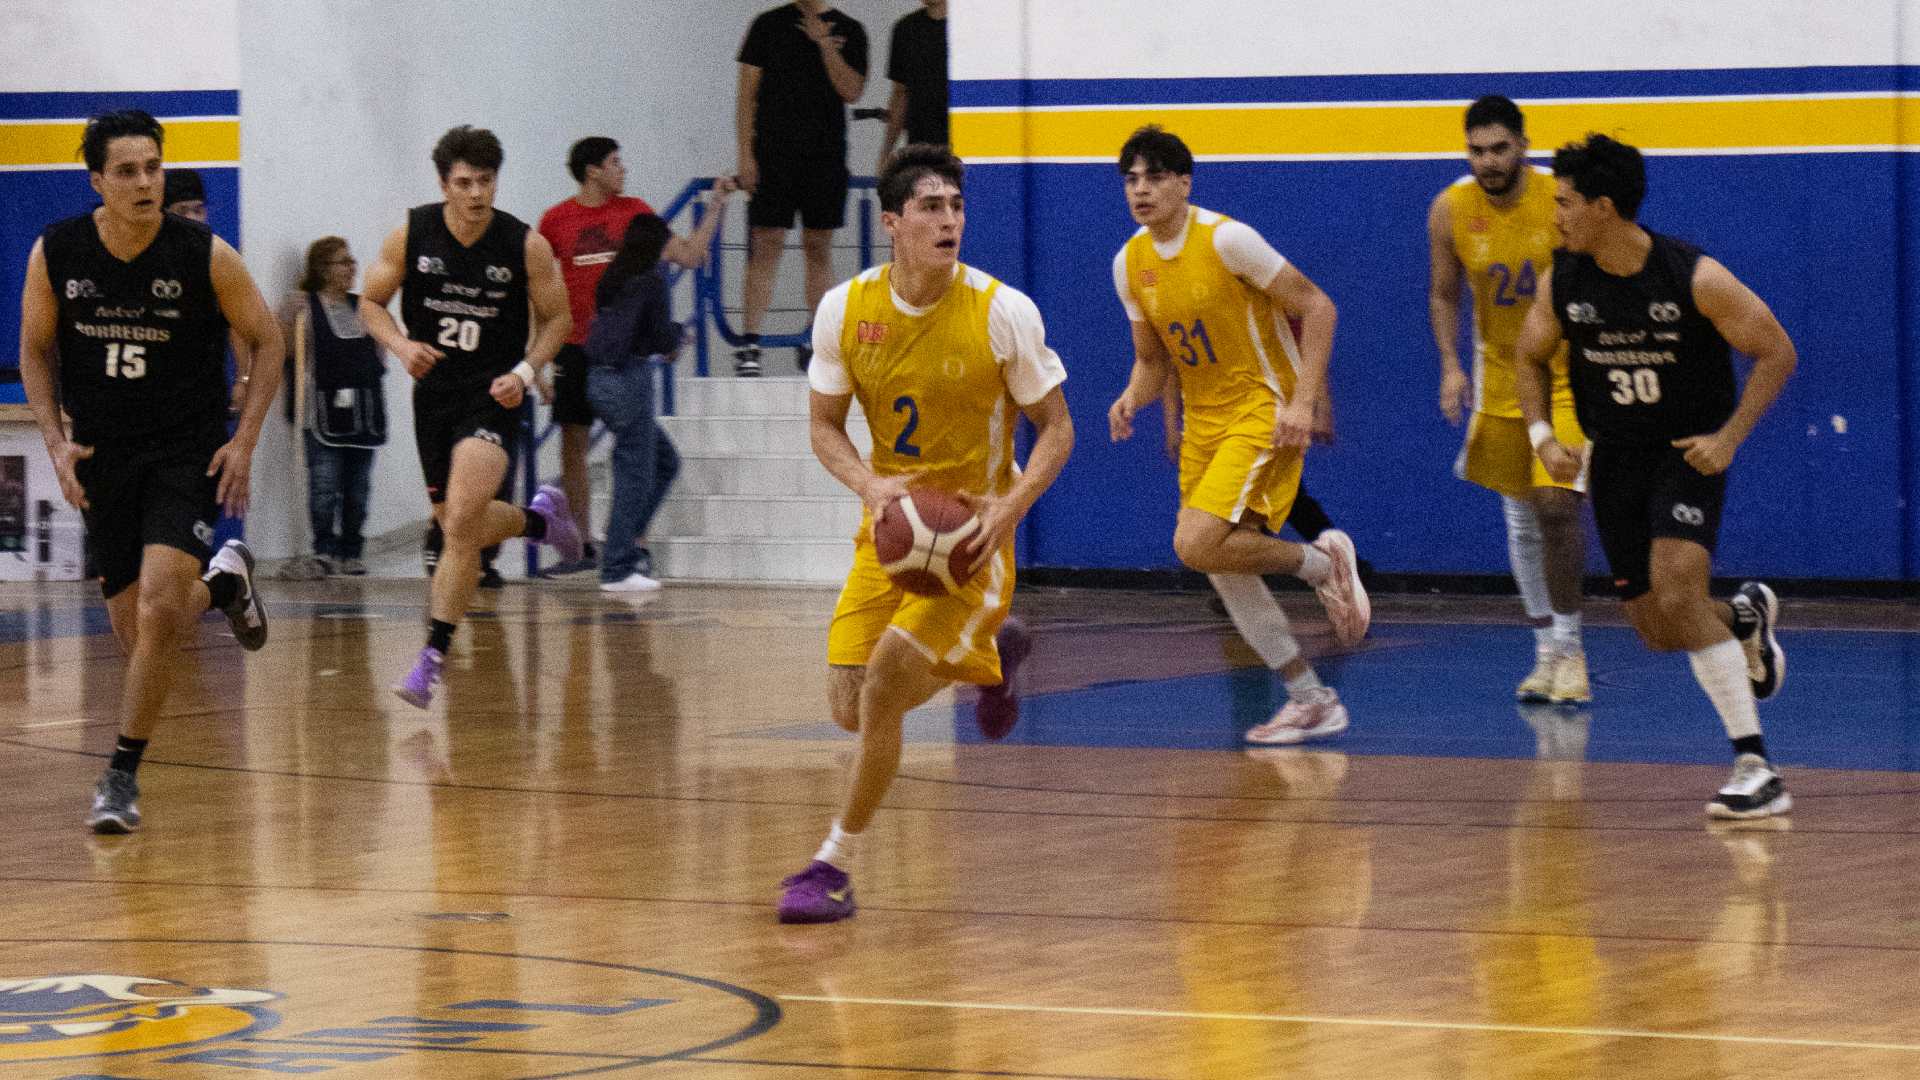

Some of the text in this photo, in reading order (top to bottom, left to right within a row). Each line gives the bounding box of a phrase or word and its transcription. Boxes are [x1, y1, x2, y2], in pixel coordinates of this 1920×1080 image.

[1487, 259, 1537, 306] 24
[437, 317, 480, 352] 20
[1168, 319, 1218, 366] 31
[104, 342, 147, 379] 15
[1607, 368, 1661, 405] 30
[893, 395, 921, 457] 2
